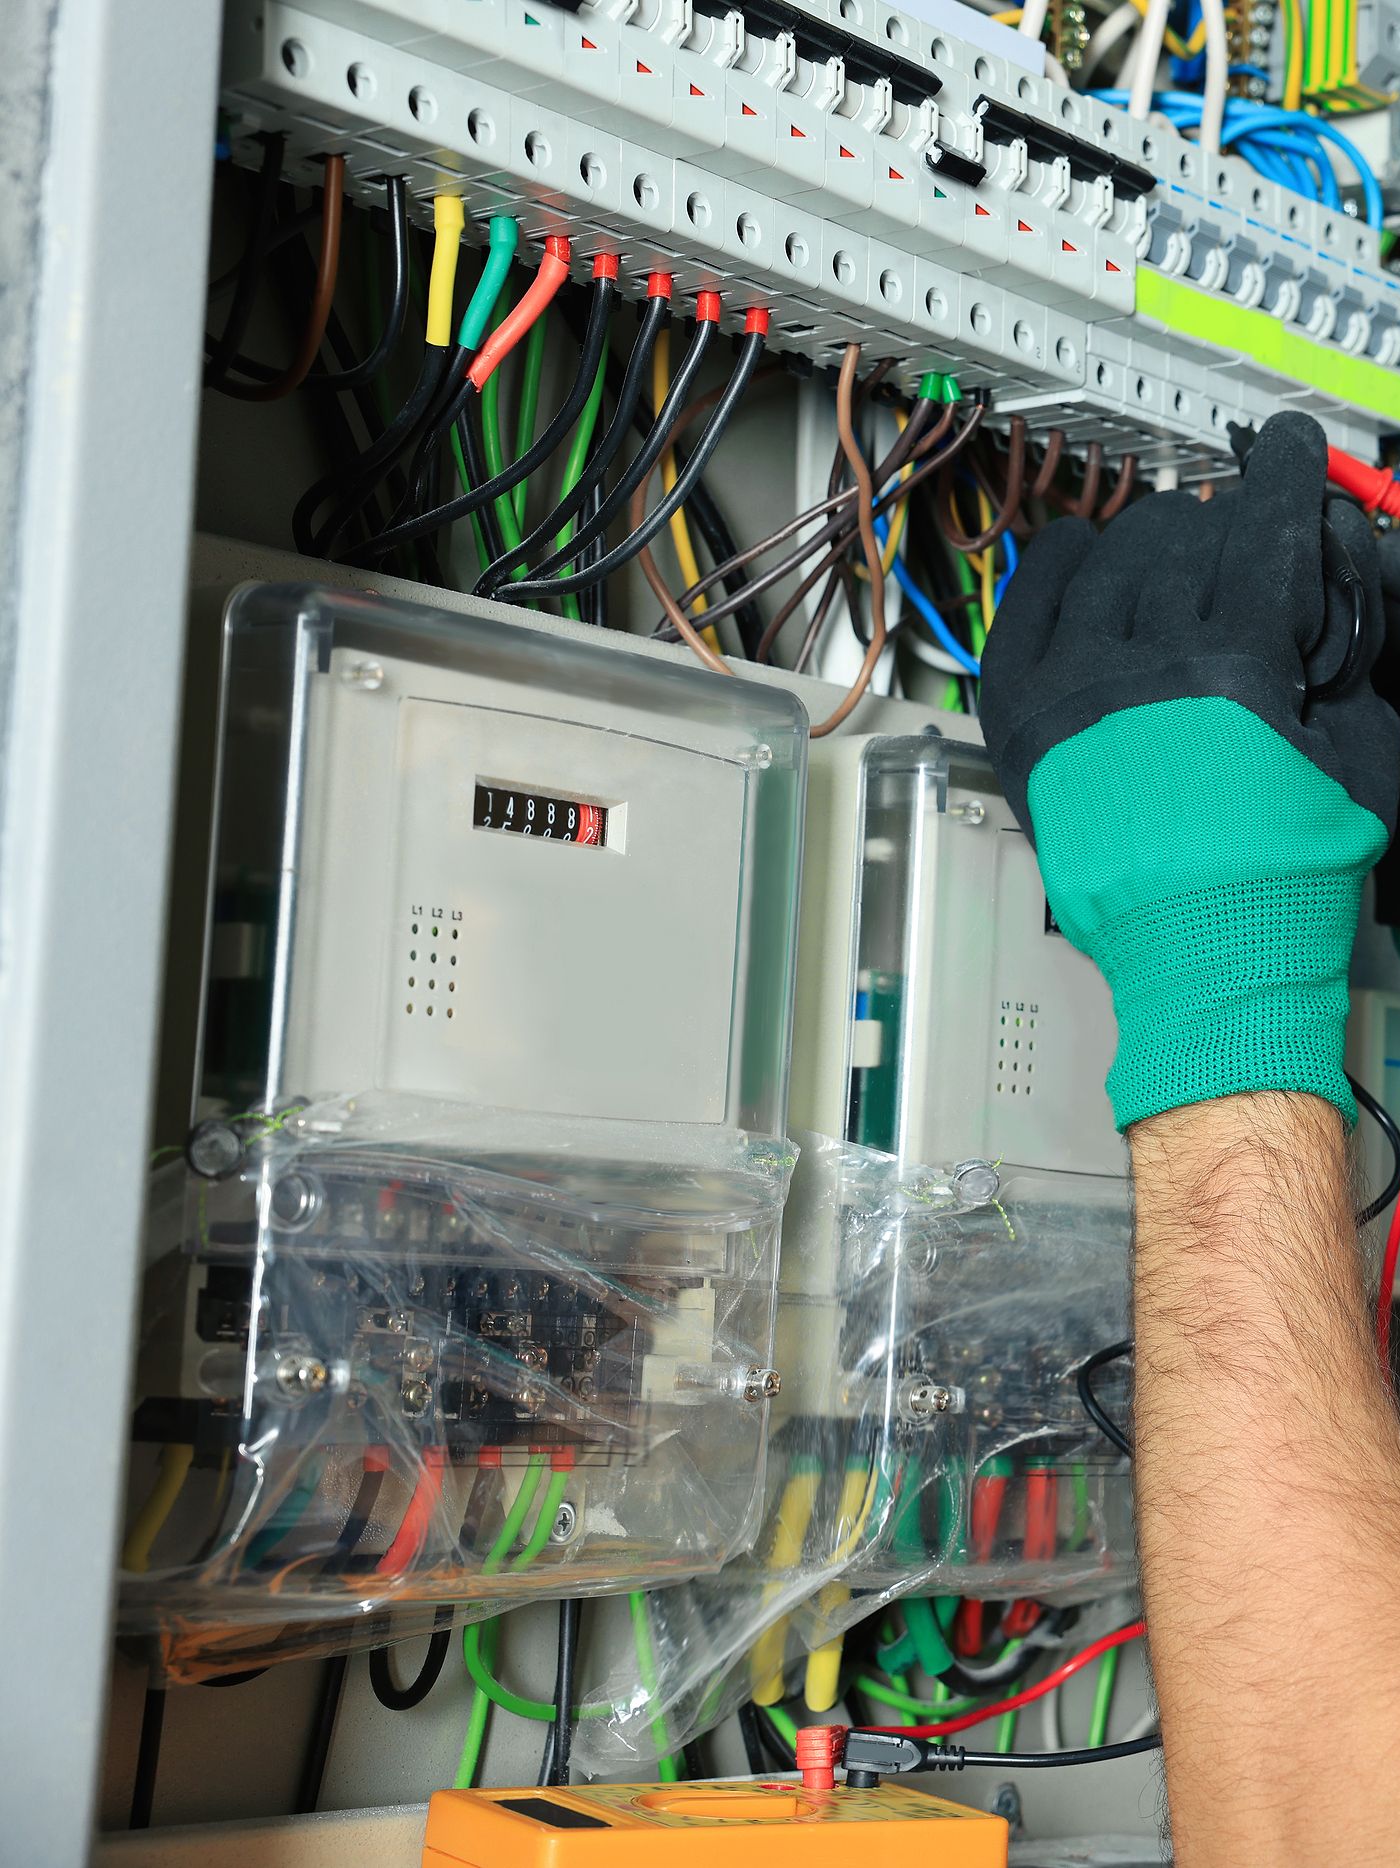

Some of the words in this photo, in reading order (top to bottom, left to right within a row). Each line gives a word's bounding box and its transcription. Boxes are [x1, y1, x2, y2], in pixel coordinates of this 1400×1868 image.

[412, 905, 422, 915] L1
[432, 907, 443, 918] L2
[452, 910, 462, 921] L3
[1016, 1002, 1024, 1011] L2
